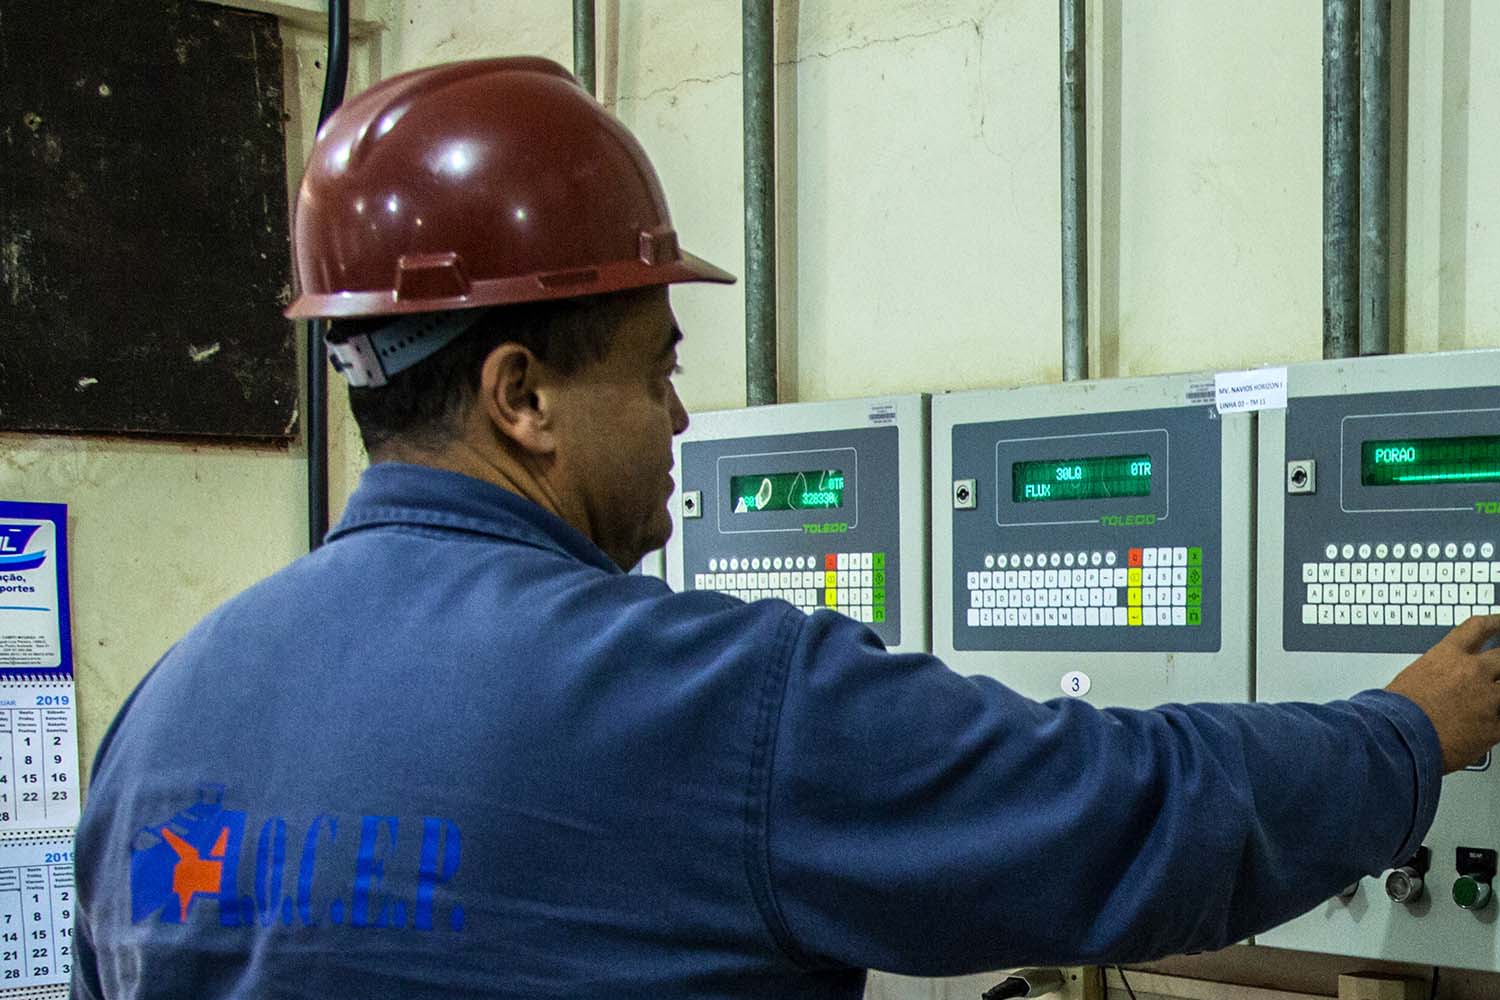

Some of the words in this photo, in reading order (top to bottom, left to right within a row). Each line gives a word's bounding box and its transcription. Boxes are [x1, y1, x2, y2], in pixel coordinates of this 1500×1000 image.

[1231, 385, 1253, 393] NAVIOS
[1375, 447, 1416, 464] PORAO
[1025, 483, 1051, 498] FLUX
[1101, 513, 1156, 526] TOLEDO
[802, 522, 849, 534] TOLEDO
[1072, 677, 1079, 692] 3
[36, 696, 69, 706] 2019
[24, 737, 31, 746] 1
[53, 737, 61, 746] 2
[25, 756, 32, 765] 8
[54, 755, 62, 764] 9
[22, 774, 37, 783] 15
[51, 773, 67, 782] 16
[23, 792, 38, 801] 22
[52, 791, 68, 800] 23
[33, 894, 39, 903] 1
[61, 892, 69, 901] 2
[4, 914, 12, 924] 7
[34, 912, 41, 921] 8
[62, 910, 70, 919] 9
[2, 933, 18, 942] 14
[32, 930, 47, 940] 15
[3, 951, 18, 960] 21
[32, 948, 48, 958] 22
[4, 970, 20, 979] 28
[34, 967, 49, 976] 29
